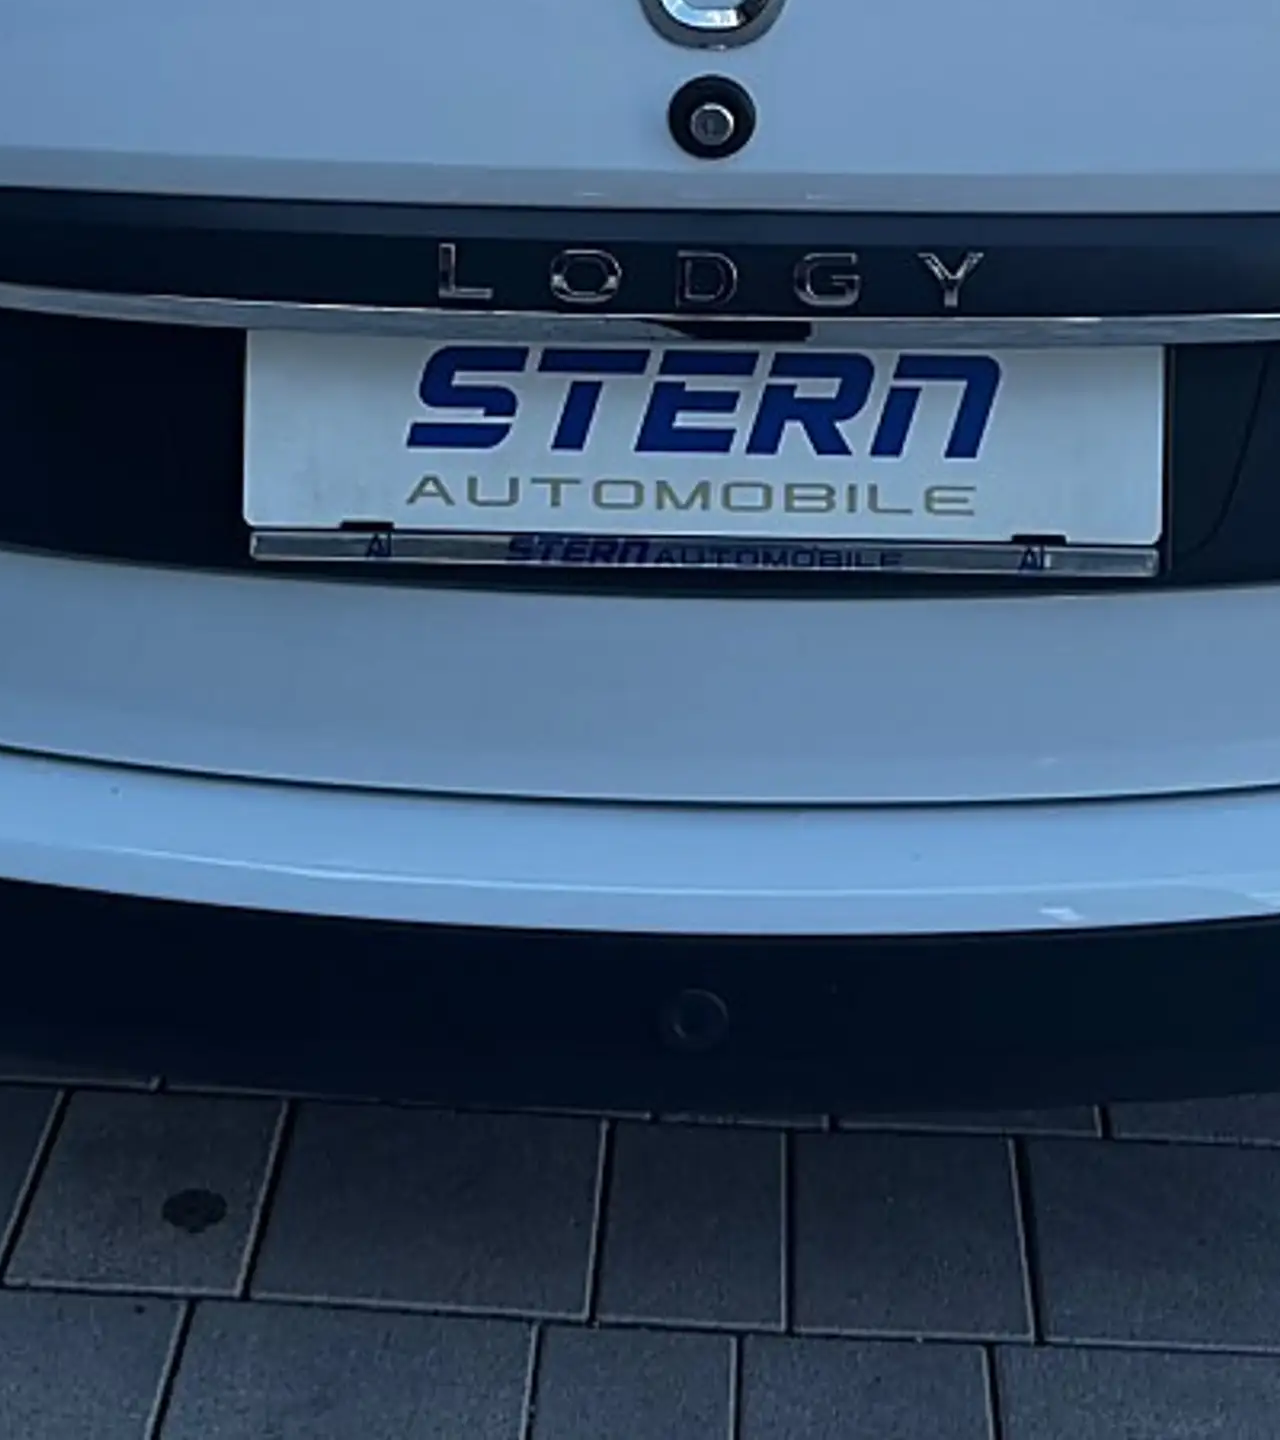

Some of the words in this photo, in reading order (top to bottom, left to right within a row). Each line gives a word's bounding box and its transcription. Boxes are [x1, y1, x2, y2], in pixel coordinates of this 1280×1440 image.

[437, 242, 985, 309] LODGY
[406, 345, 1002, 460] STERN
[406, 474, 978, 517] AUTOMOBILE
[506, 534, 651, 563] STERN
[653, 544, 904, 570] AUTOMOBILE
